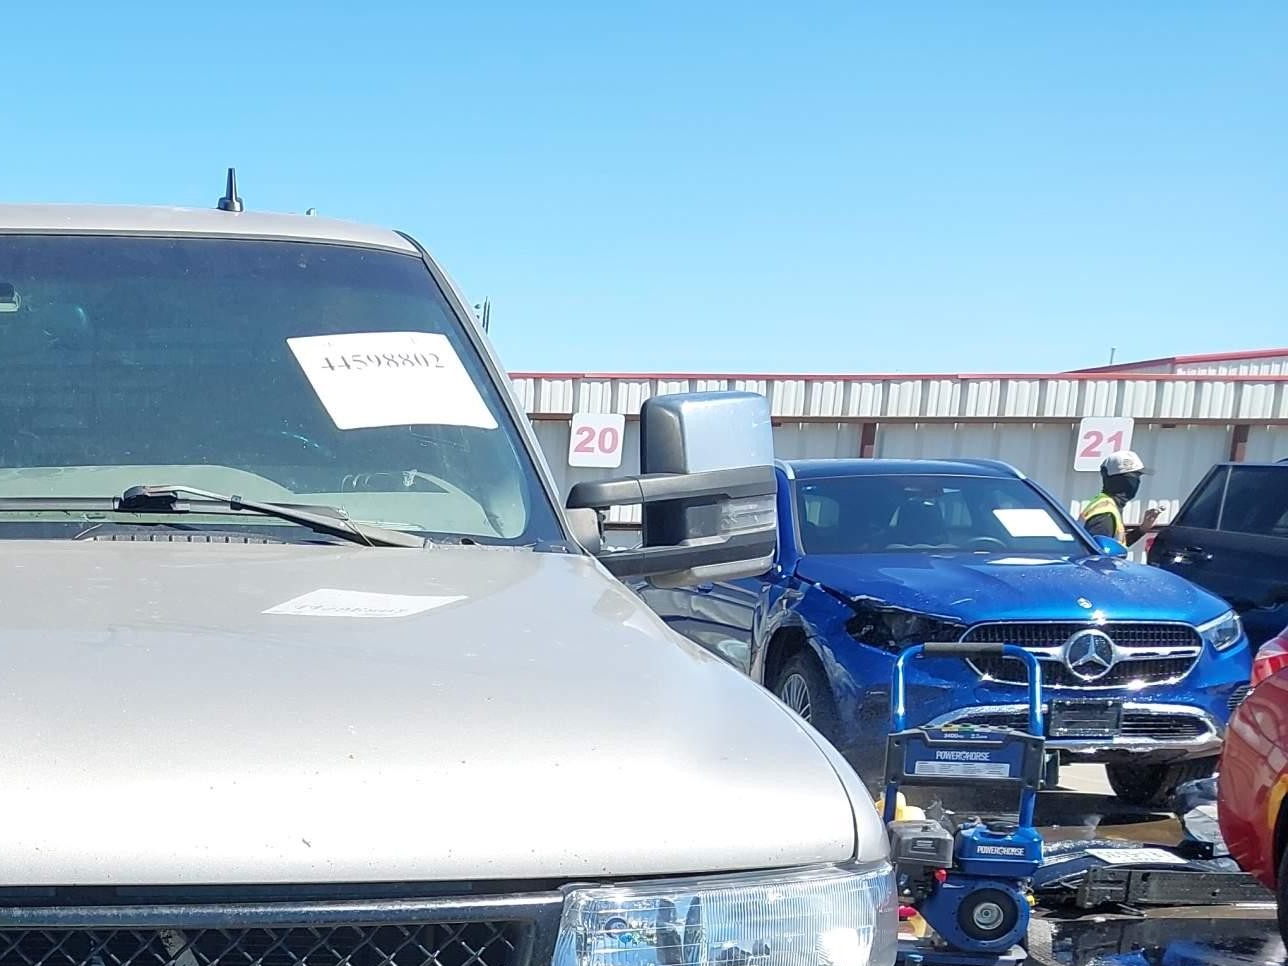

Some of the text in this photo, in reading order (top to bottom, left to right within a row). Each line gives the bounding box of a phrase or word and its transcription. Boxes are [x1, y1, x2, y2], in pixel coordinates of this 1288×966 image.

[321, 352, 446, 371] 44598802
[574, 426, 619, 454] 20
[1079, 430, 1124, 458] 21
